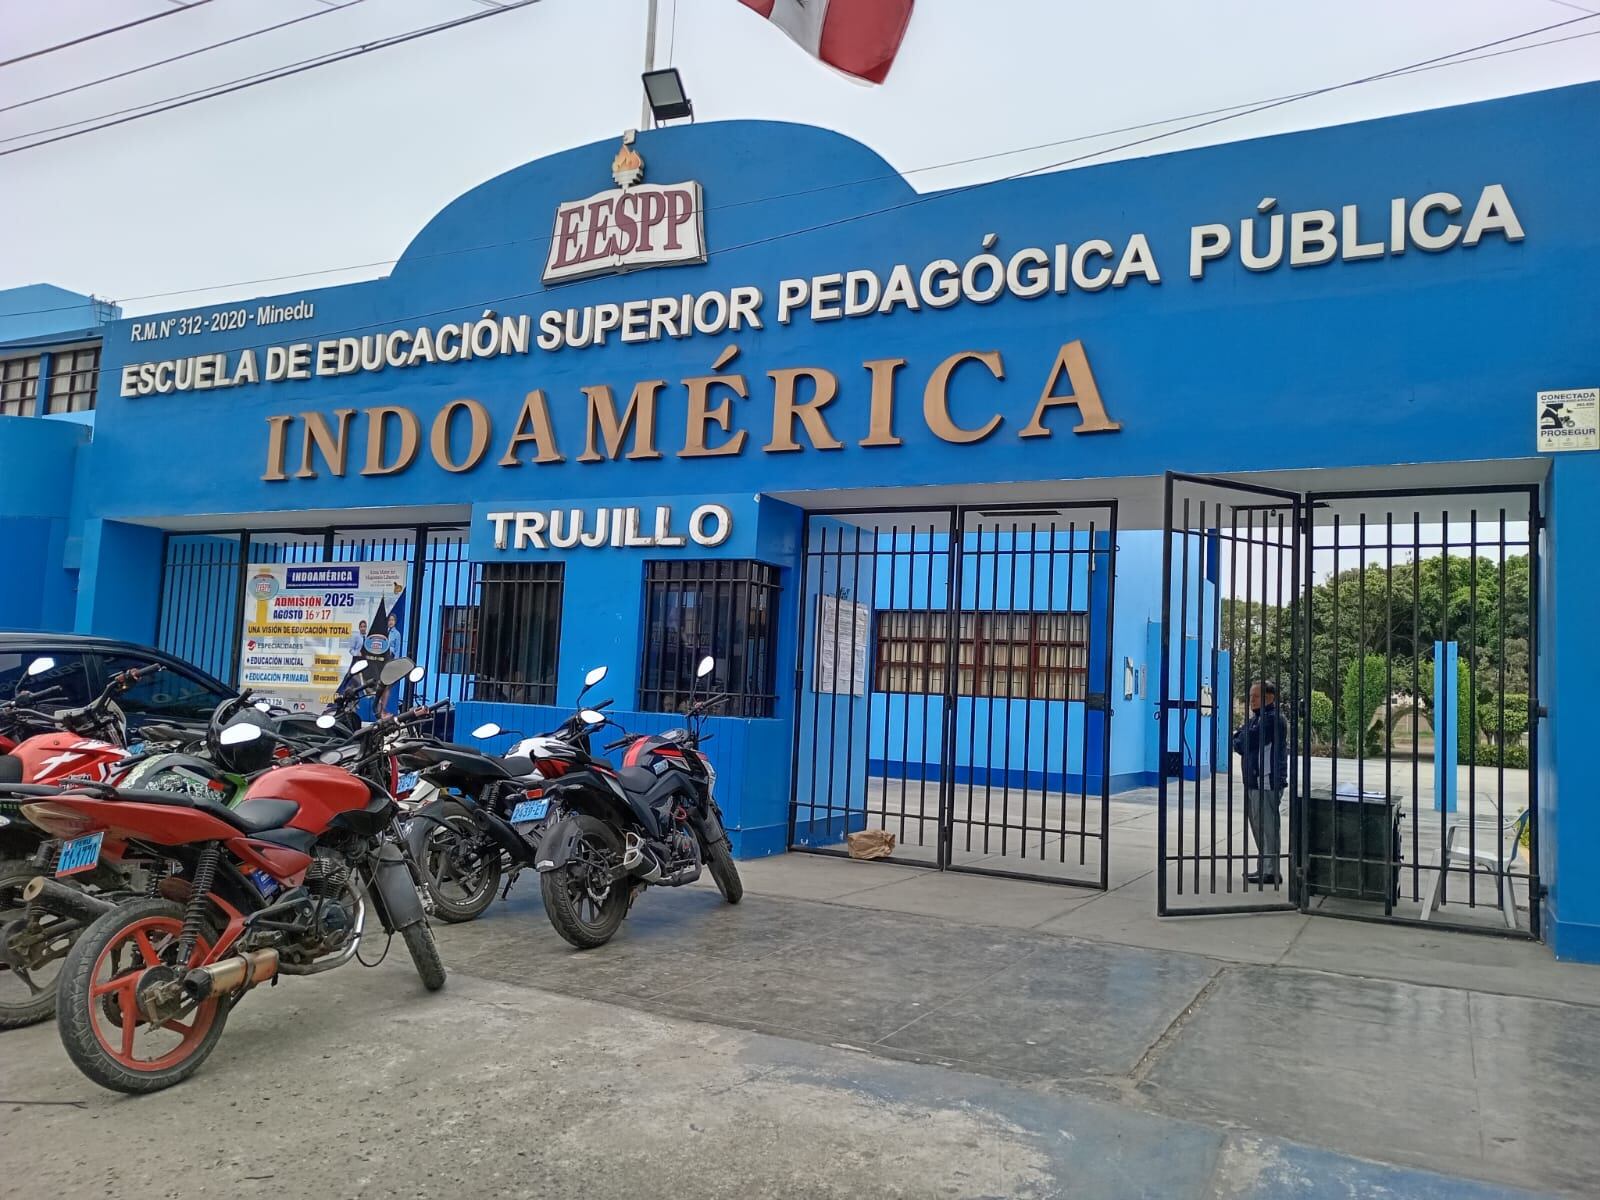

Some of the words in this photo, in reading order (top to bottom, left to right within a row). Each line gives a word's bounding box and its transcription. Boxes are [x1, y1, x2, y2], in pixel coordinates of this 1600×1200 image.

[550, 189, 693, 270] EESPP
[119, 349, 259, 398] ESCUELA
[265, 343, 312, 382] DE
[316, 309, 531, 377] EDUCACIÓN
[537, 286, 763, 351] SUPERIOR
[777, 233, 1161, 324] PEDAGÓGICA
[1189, 184, 1525, 280] PÚBLICA
[256, 299, 314, 325] Minedu
[1540, 392, 1596, 401] CONECTADA
[260, 339, 1122, 482] INDOAMÉRICA
[1540, 428, 1596, 437] PROSEGUR
[487, 504, 732, 549] TRUJILLO
[291, 569, 353, 582] INDOAMÉRICA
[274, 595, 321, 607] ADMISIÓN
[324, 593, 354, 607] 2025
[273, 609, 303, 620] AGOSTO
[305, 609, 315, 620] 16
[321, 609, 331, 620] 17
[248, 626, 260, 634] UNA
[262, 625, 282, 634] VISIÓN
[283, 626, 291, 634] DE
[291, 625, 328, 634] EDUCACIÓN
[329, 626, 350, 635] TOTAL
[250, 656, 283, 666] EDUCACIÓN
[283, 657, 304, 666] INICIAL
[248, 672, 281, 682] EDUCACIÓN
[282, 673, 309, 683] PRIMARIA
